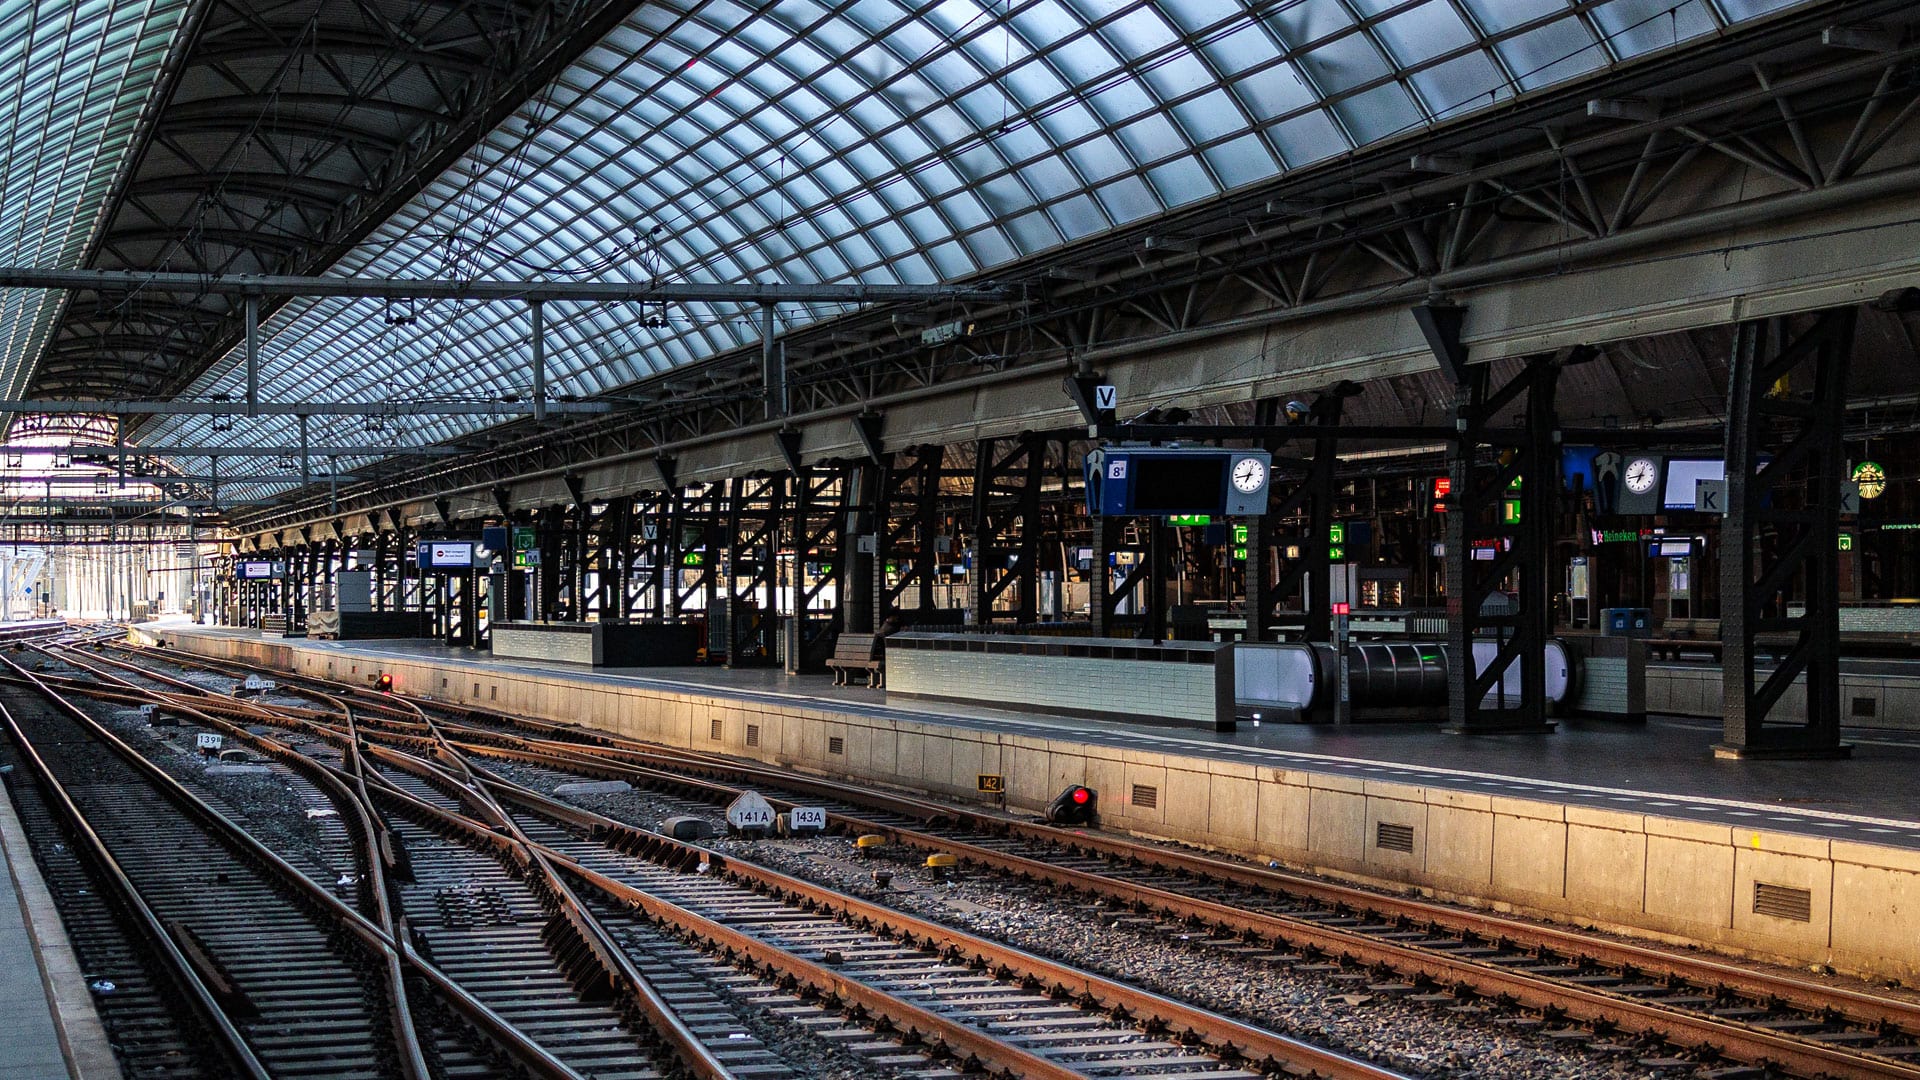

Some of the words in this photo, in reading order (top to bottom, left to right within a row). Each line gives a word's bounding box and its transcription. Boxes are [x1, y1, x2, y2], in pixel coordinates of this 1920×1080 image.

[1098, 387, 1115, 407] V
[1703, 491, 1718, 509] K
[645, 526, 657, 538] V
[1603, 530, 1637, 542] Heineken
[863, 541, 871, 551] L
[528, 555, 538, 563] M
[200, 735, 221, 744] 139B
[983, 777, 997, 789] 142
[739, 811, 769, 823] 141A
[796, 811, 822, 823] 143A
